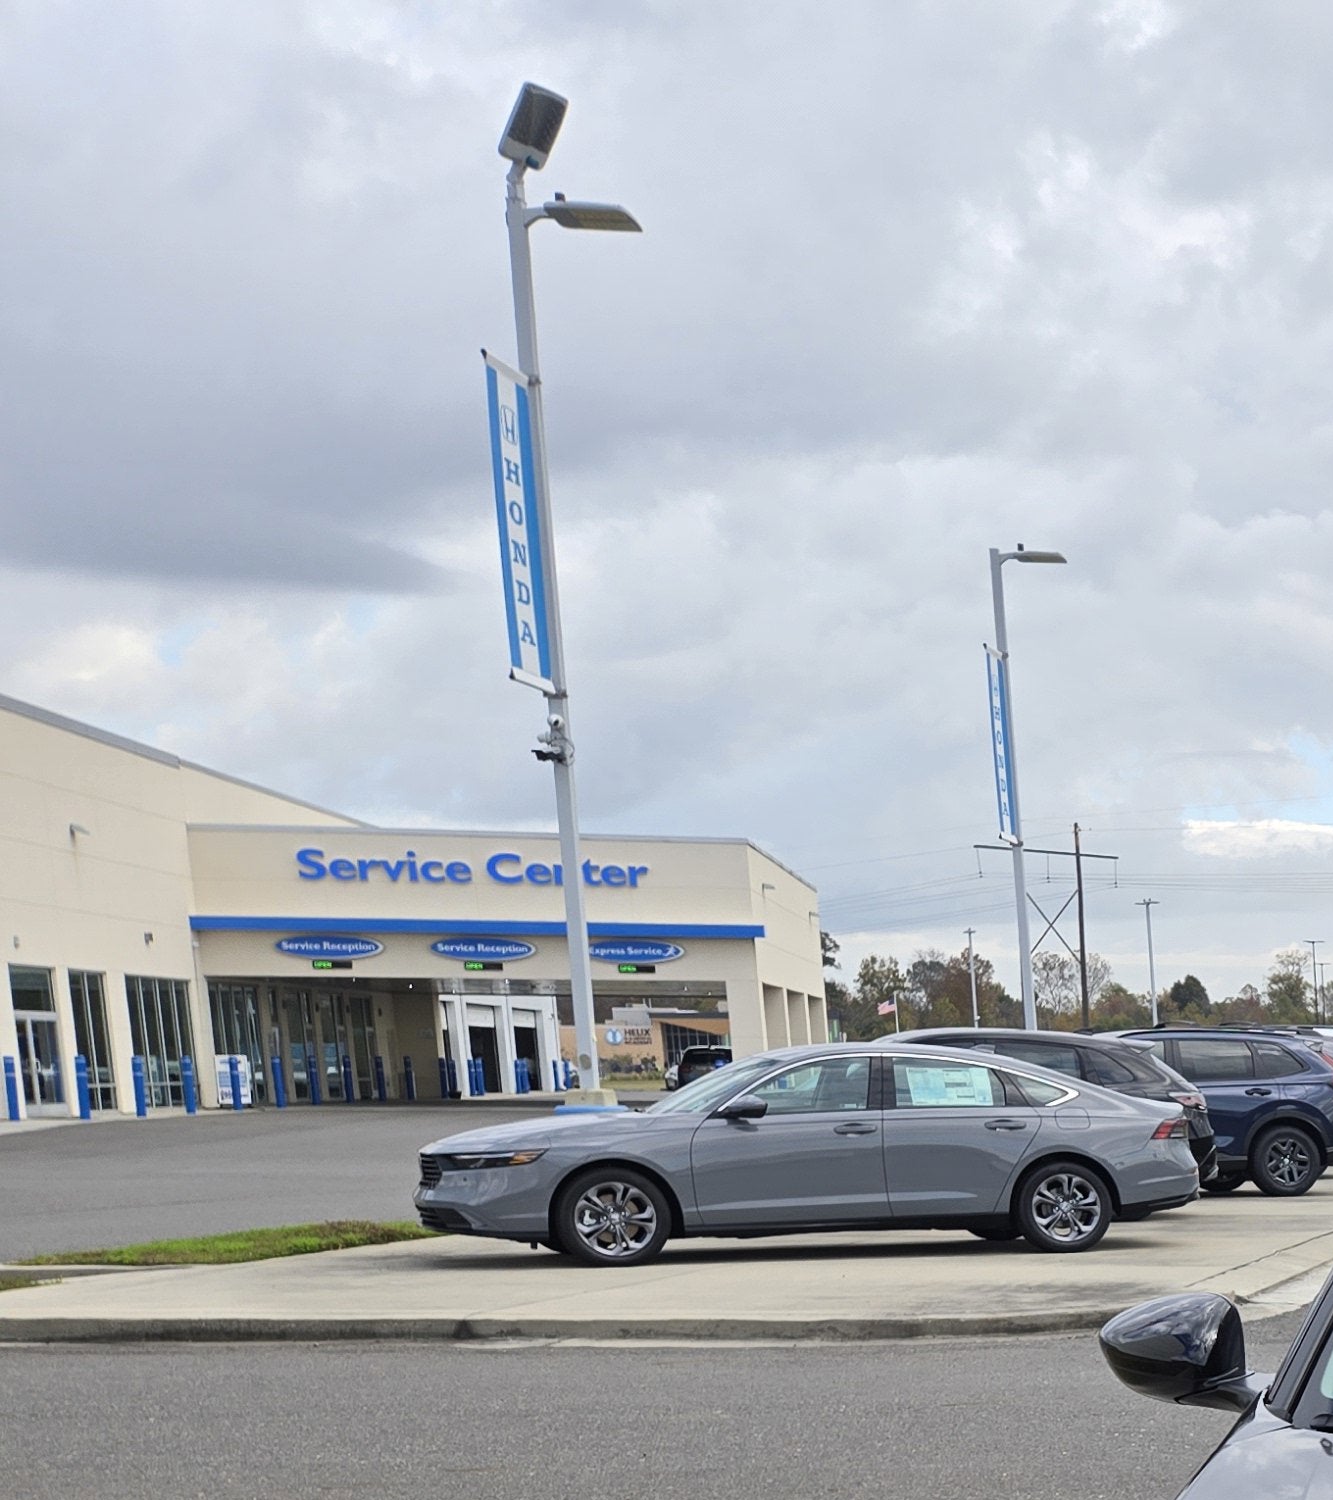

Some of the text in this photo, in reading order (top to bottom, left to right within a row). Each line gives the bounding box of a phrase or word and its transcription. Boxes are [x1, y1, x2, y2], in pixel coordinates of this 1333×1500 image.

[504, 457, 536, 647] HONDA
[993, 705, 1010, 817] HONDA
[296, 849, 472, 883] Service
[281, 941, 375, 953] Service Reception
[437, 943, 528, 954] Service Reception
[589, 946, 662, 956] Express Service
[624, 1028, 650, 1036] HELIX
